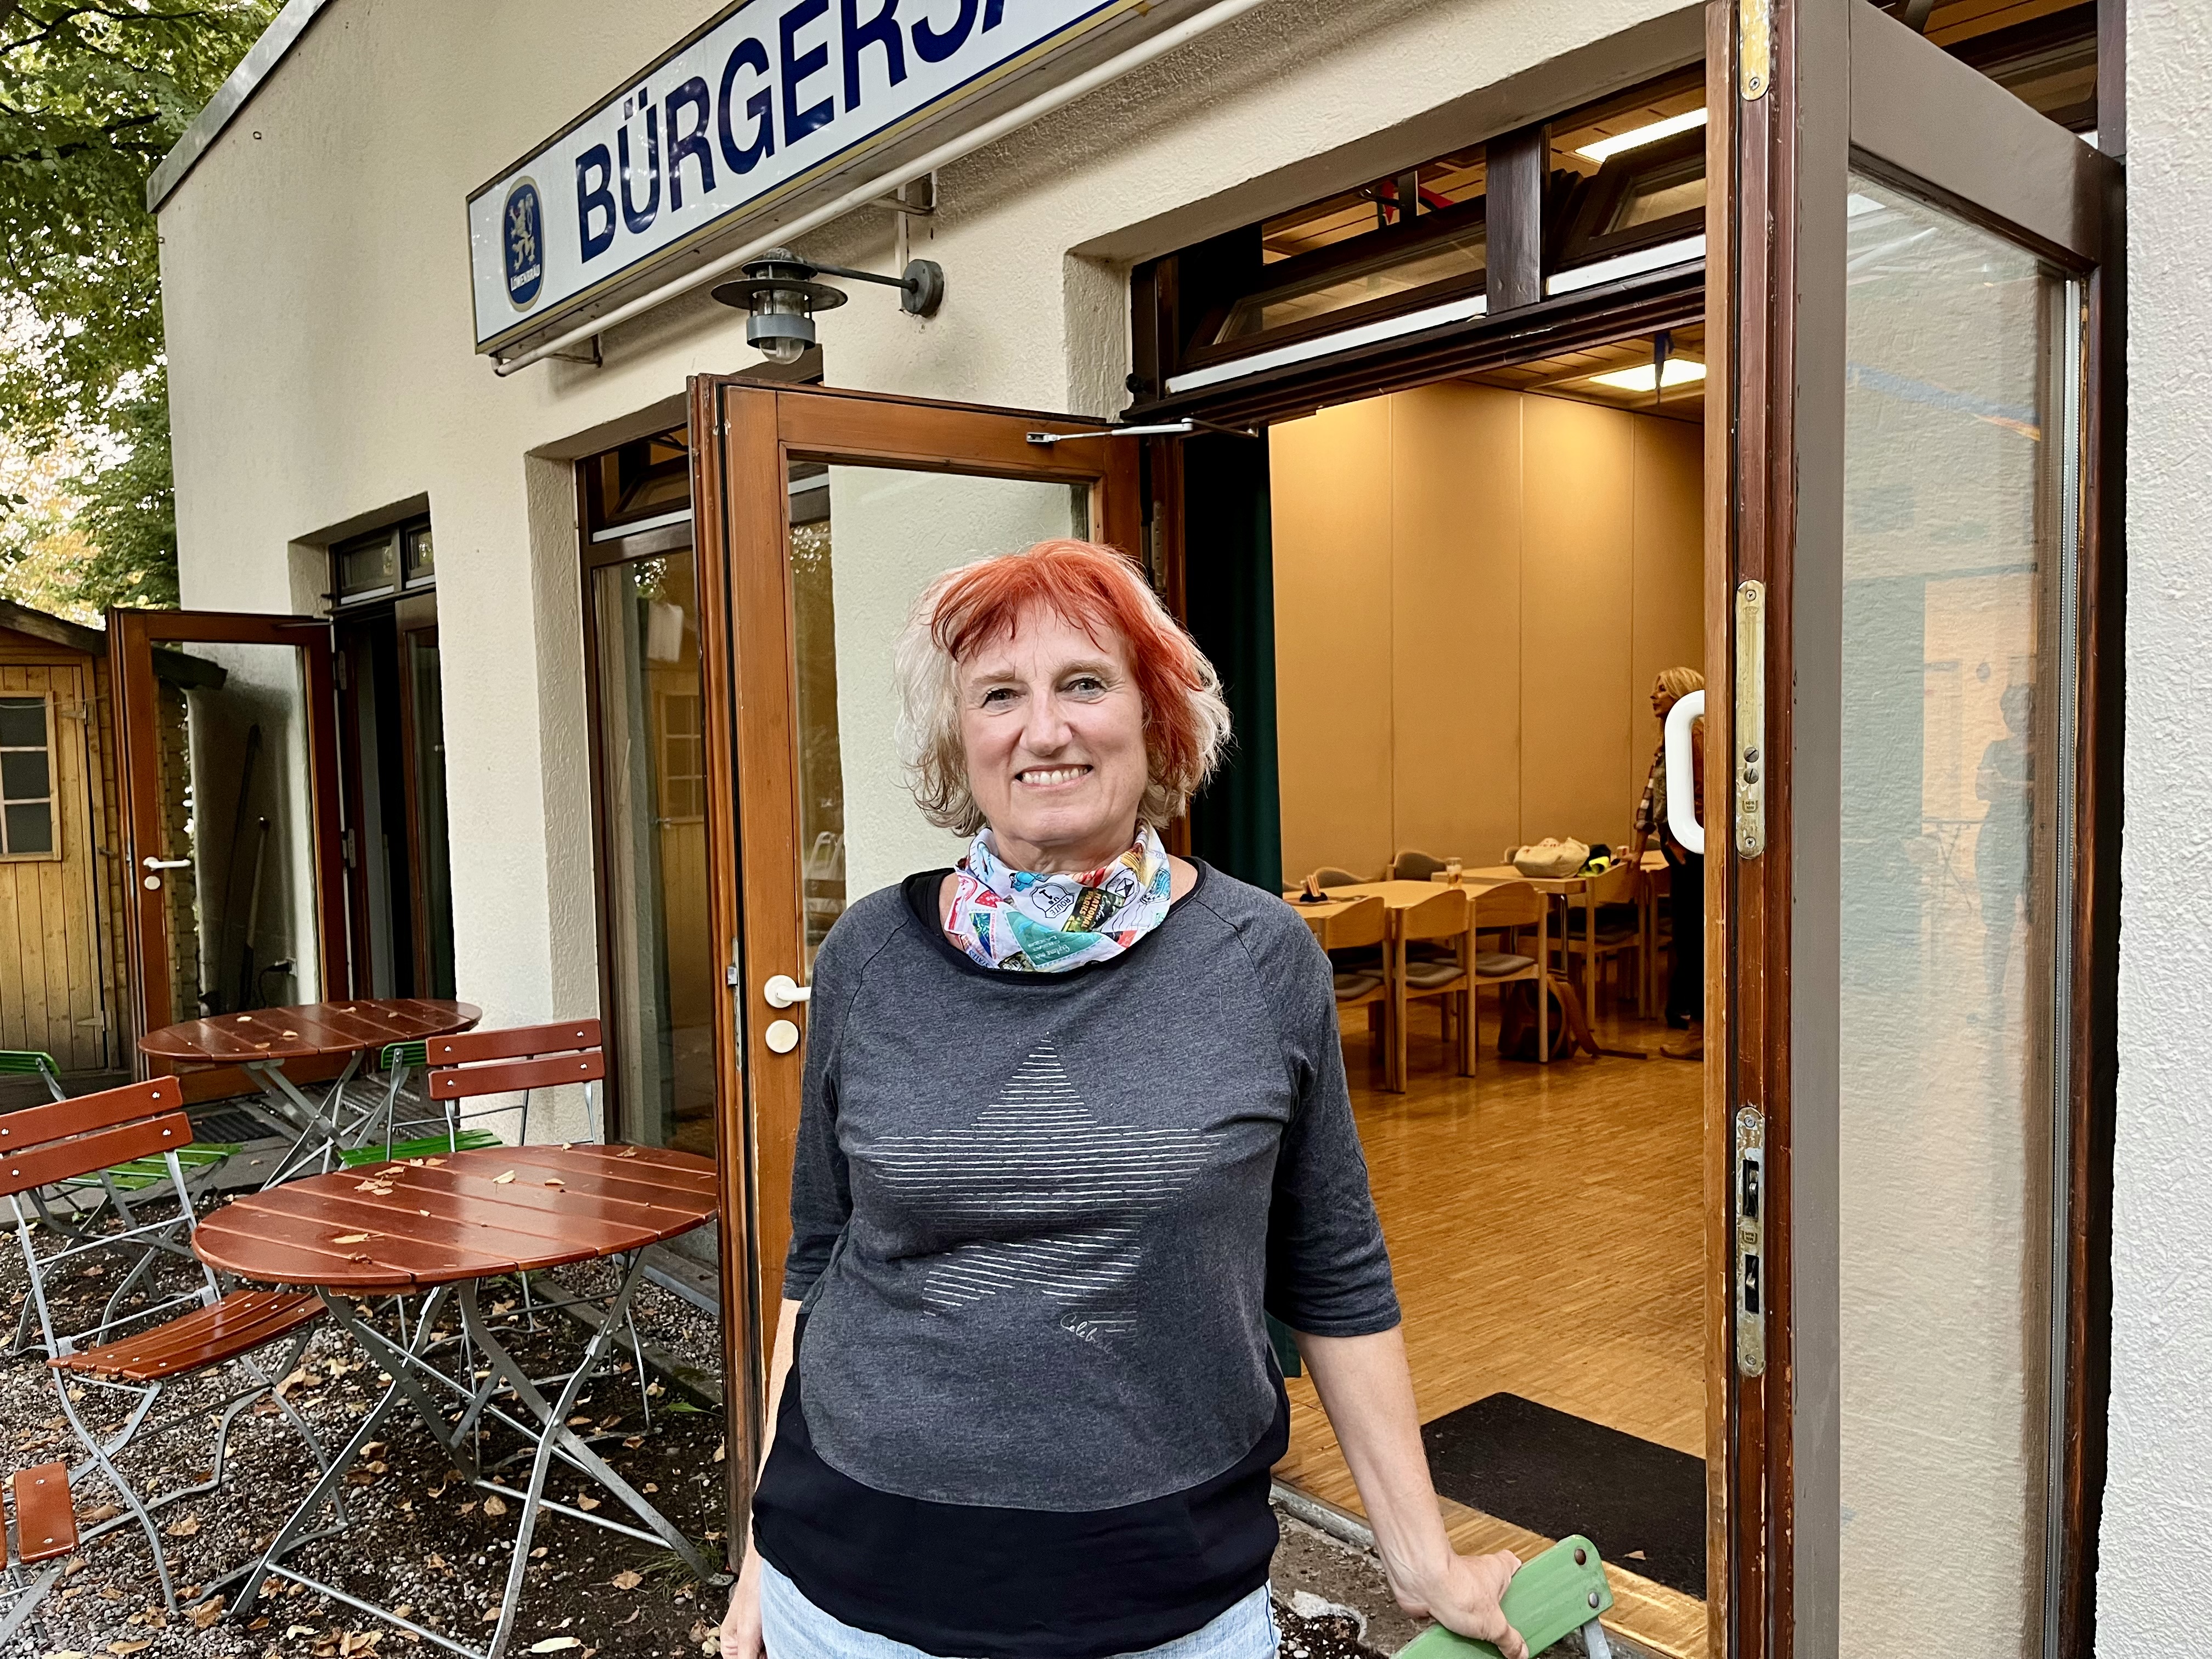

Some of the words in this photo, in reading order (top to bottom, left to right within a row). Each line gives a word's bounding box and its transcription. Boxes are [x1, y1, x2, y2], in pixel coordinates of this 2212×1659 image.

[1039, 889, 1053, 900] 1
[1080, 890, 1093, 915] PARKS
[1049, 897, 1071, 916] ROUTE
[1081, 893, 1102, 928] NATIONAL
